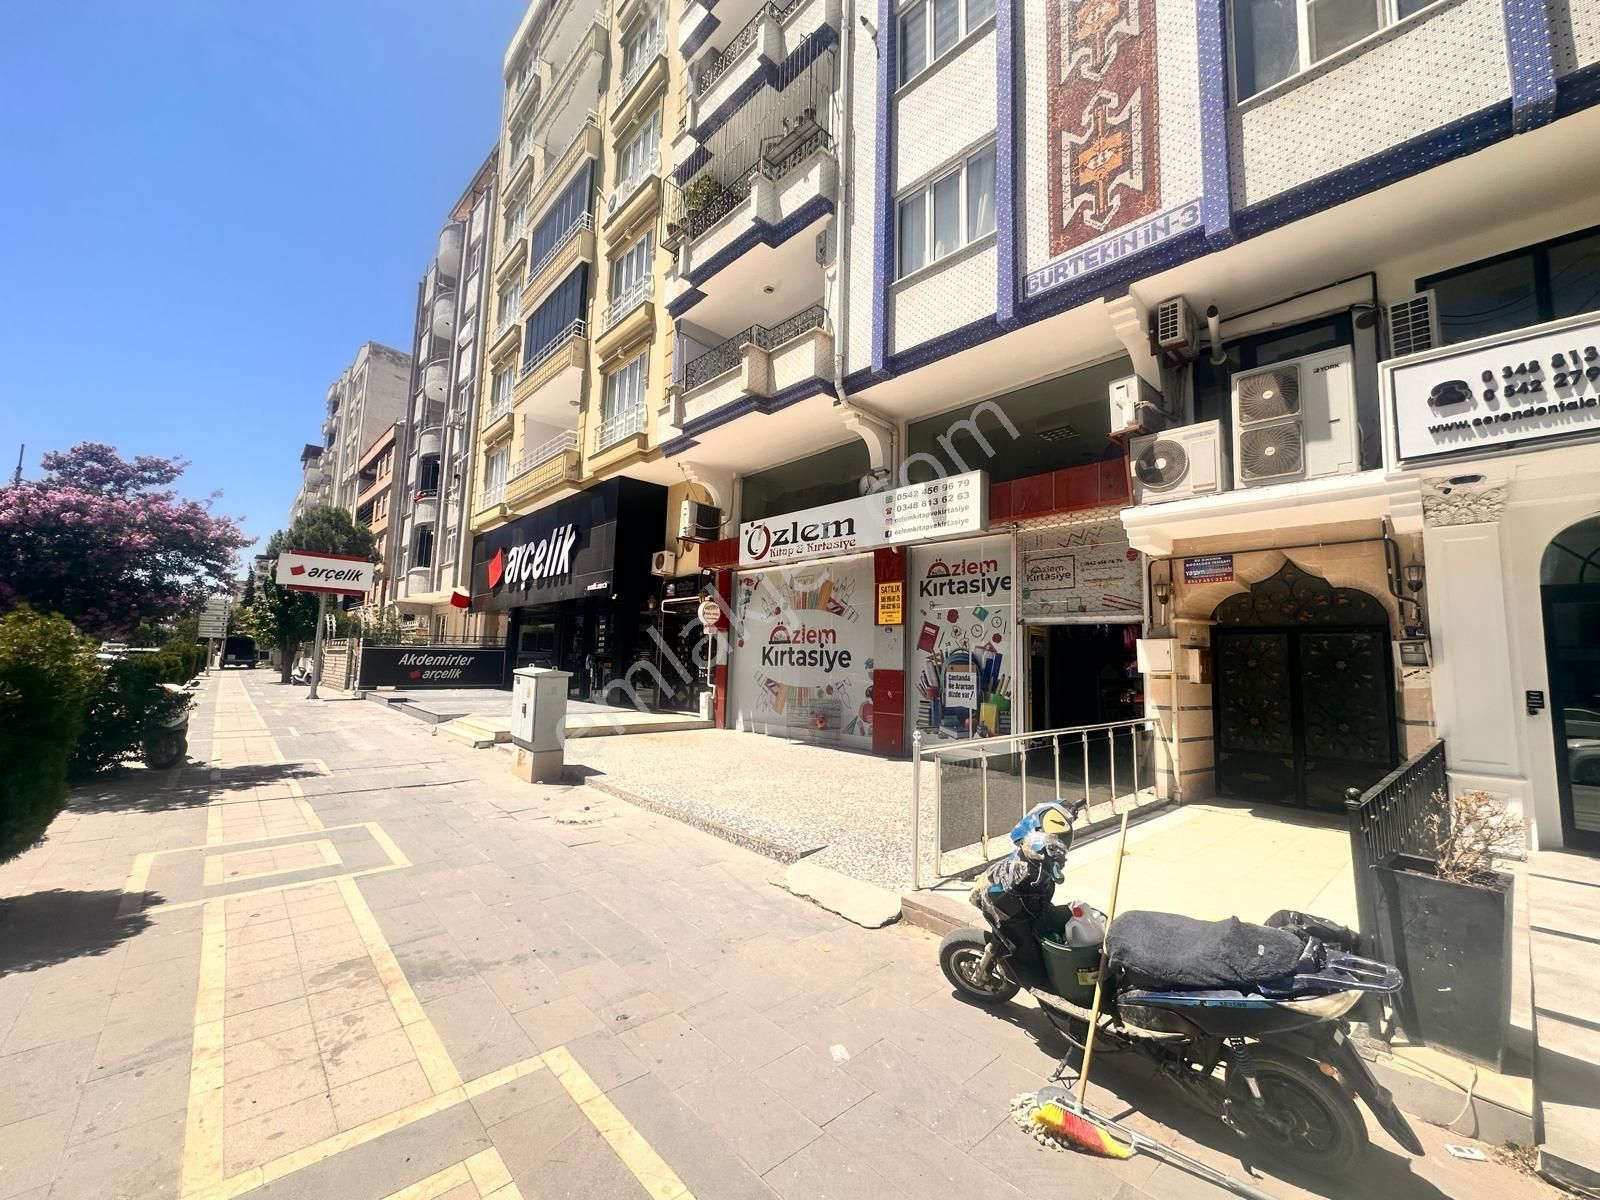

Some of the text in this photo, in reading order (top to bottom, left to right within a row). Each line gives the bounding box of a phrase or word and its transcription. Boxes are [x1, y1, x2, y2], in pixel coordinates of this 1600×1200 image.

[1320, 363, 1340, 371] YORK
[1481, 345, 1600, 383] 0 348 813
[1483, 366, 1600, 401] 0 542 279
[1428, 395, 1600, 434] www.cerendentalc
[897, 479, 970, 501] 0542 456 96 79
[897, 491, 970, 513] 0348 813 62 63
[745, 517, 856, 560] Özlem
[796, 544, 804, 554] &
[504, 523, 576, 591] arçelik
[926, 558, 998, 578] Özlem
[308, 567, 363, 582] arçelik
[919, 573, 1011, 597] Kırtasiye
[880, 585, 901, 593] SATILIK
[768, 621, 837, 645] Özlem
[398, 653, 475, 666] Akdemirler
[762, 643, 852, 673] Kırtasiye
[422, 668, 463, 681] arçelik
